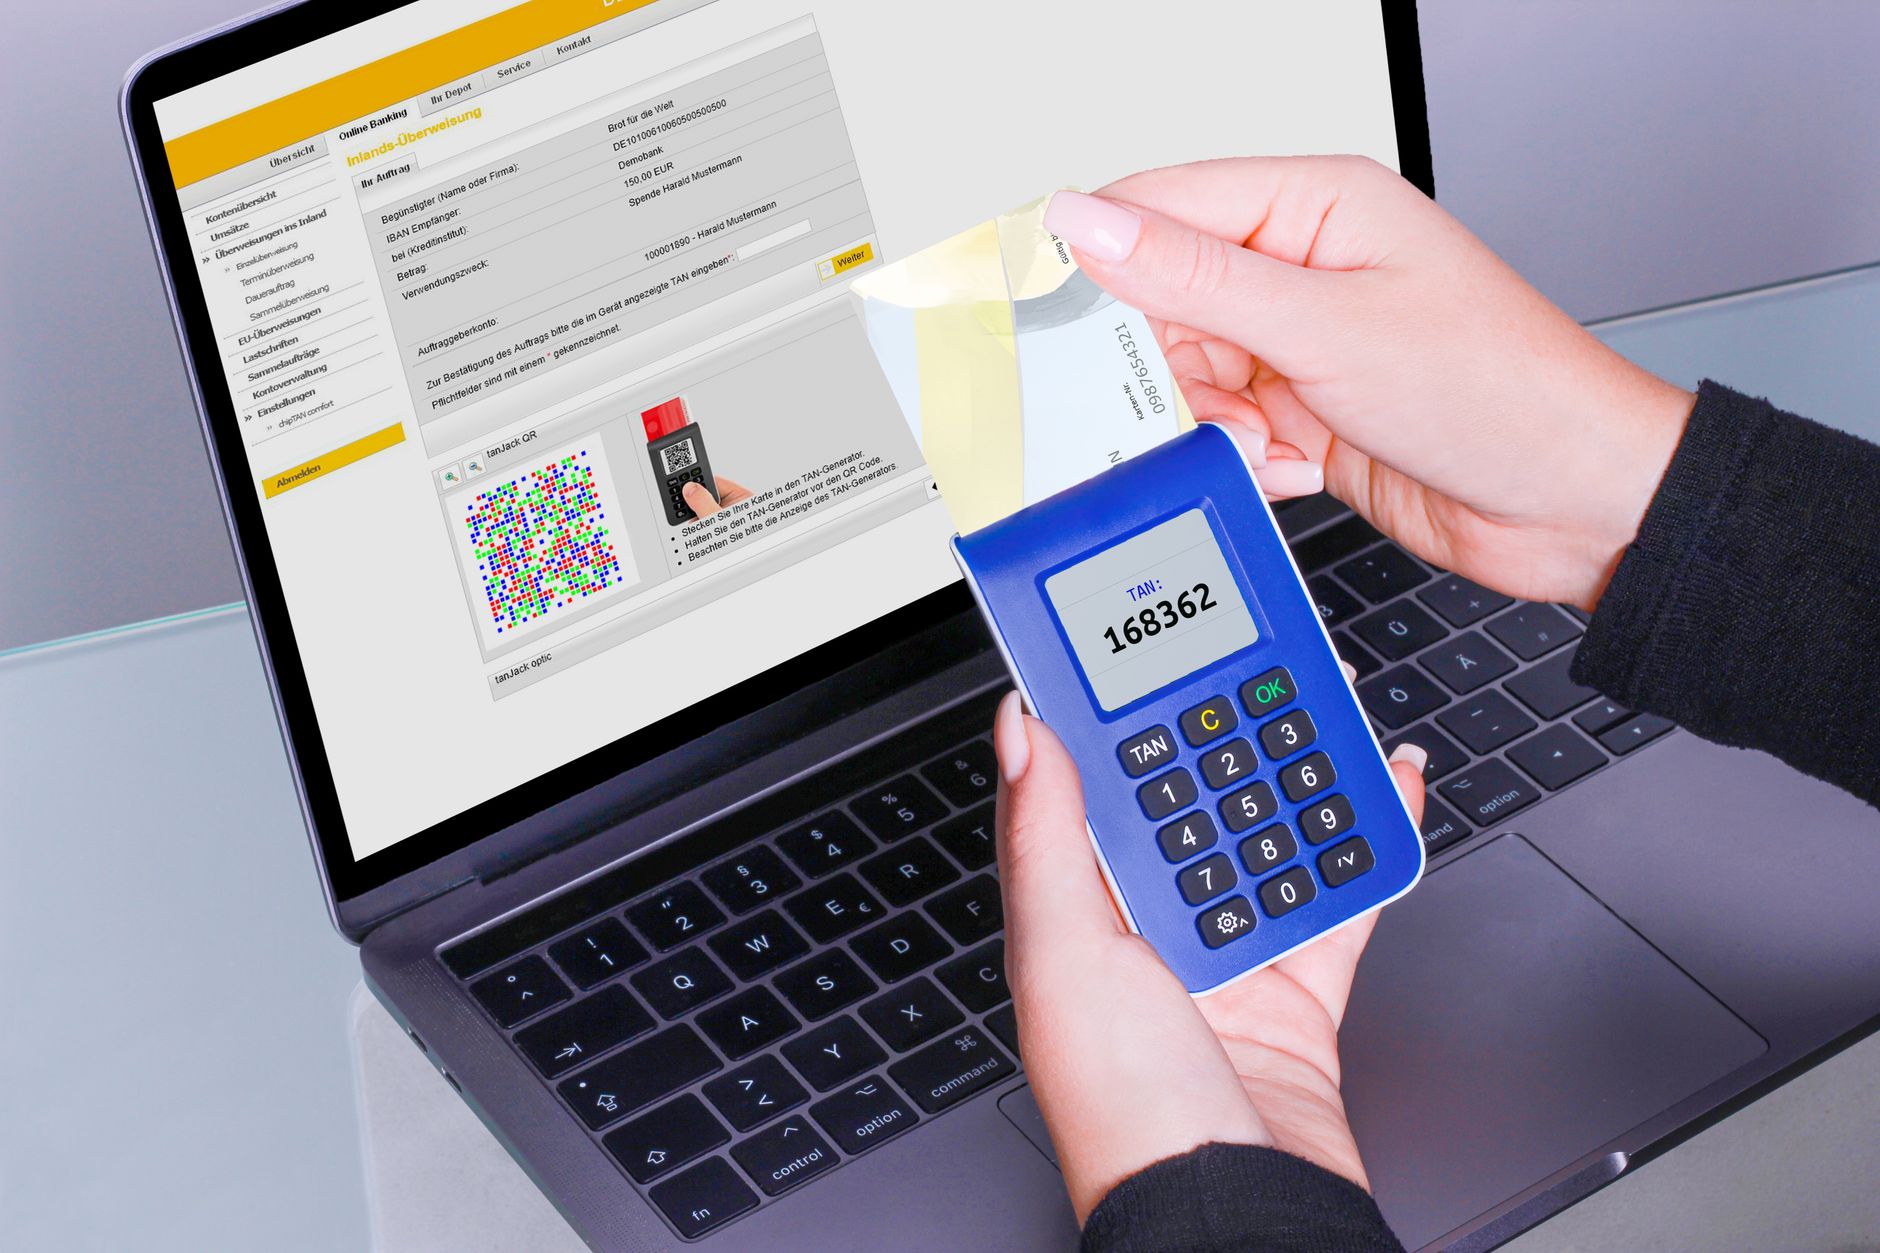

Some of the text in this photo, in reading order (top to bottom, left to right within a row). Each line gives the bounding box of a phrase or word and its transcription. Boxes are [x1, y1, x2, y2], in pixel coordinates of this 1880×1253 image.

[556, 35, 592, 55] Kontakt
[496, 60, 531, 79] Service
[430, 82, 472, 105] Ihr Depot
[338, 108, 408, 141] Online Banking
[607, 100, 675, 133] Brot für die Welt
[612, 98, 727, 152] DE10100610060500500500
[346, 107, 482, 168] Inlands-Überweisung
[269, 144, 315, 168] Übersicht
[617, 146, 664, 171] Demobank
[360, 164, 411, 189] Ihr Auftrag
[623, 161, 674, 188] 150,00 EUR
[628, 155, 743, 207] Spende Harald Mustermann
[381, 163, 520, 225] Begünstigter (Name oder Firma):
[205, 190, 277, 225] Kontenübersicht
[210, 222, 250, 242] Umsätze
[215, 208, 327, 260] Überweisungen ins Inland
[386, 208, 461, 244] IBAN Empfänger:
[644, 201, 777, 261] 100001890 Harald Mustermann
[391, 225, 469, 263] bei (Kreditinstitut):
[1055, 241, 1070, 265] Gültig
[239, 253, 315, 287] Terminüberweisung
[837, 251, 865, 267] Weiter
[396, 264, 429, 282] Betrag:
[401, 259, 489, 301] Verwendungszweck:
[244, 279, 296, 305] Dauerauftrag
[249, 284, 330, 322] Sammelüberweisung
[238, 307, 322, 346] EU-Überweisungen
[418, 318, 499, 357] Auftraggeberkonto:
[425, 377, 442, 390] Zur
[442, 356, 495, 383] Bestätigung
[495, 348, 513, 361] des
[514, 332, 550, 354] Auftrags
[550, 324, 570, 337] bitte
[571, 318, 585, 329] die
[585, 312, 597, 323] im
[598, 300, 623, 317] Gerät
[623, 282, 670, 307] angezeigte
[670, 272, 690, 286] TAN
[242, 336, 299, 364] Lastschriften
[247, 347, 321, 382] Sammelaufträge
[431, 323, 622, 410] Pflichtfelder sind mit einem gekennzeichnet.
[1114, 321, 1166, 415] 0987654321
[252, 364, 328, 400] Kontoverwaltung
[257, 389, 316, 418] Einstellungen
[1122, 381, 1145, 421] Karten-Nr.
[278, 400, 335, 428] chipTAN comfort
[486, 430, 538, 459] tanJack QR
[1107, 450, 1124, 466] N
[276, 464, 321, 489] Abmelden
[681, 450, 865, 537] Stecken Sie Ihre Karte in den TAN-Generator.
[684, 456, 883, 550] Halten Sie den TAN-Generator vor den QR Code.
[687, 462, 899, 562] Beachten Sie bitte die Anzeige des TAN-Generators.
[1126, 579, 1163, 603] TAN:
[1103, 579, 1218, 655] 168362
[1388, 620, 1408, 636] Ü
[494, 653, 553, 684] tanJack optic
[1455, 653, 1477, 670] Ä
[1255, 678, 1287, 704] OK
[1388, 687, 1409, 703] Ö
[1200, 709, 1220, 731] C
[1280, 723, 1298, 745] 3
[1129, 735, 1169, 766] TAN
[1220, 752, 1240, 776] 2
[1300, 765, 1318, 787] 6
[970, 772, 987, 787] 6
[1162, 782, 1177, 804] 1
[1479, 790, 1520, 814] option
[897, 807, 915, 822] 5
[1241, 794, 1258, 818] 5
[1320, 808, 1337, 830] 9
[971, 826, 989, 841] T
[1182, 825, 1197, 846] 4
[828, 843, 842, 857] 4
[1260, 838, 1278, 861] 8
[898, 863, 920, 879] R
[1197, 866, 1212, 891] 7
[750, 879, 768, 894] 3
[1280, 882, 1297, 904] 0
[824, 899, 845, 916] E
[966, 900, 981, 916] F
[675, 916, 694, 931] 2
[745, 934, 770, 953] W
[890, 938, 910, 954] D
[599, 953, 614, 966] 1
[673, 974, 695, 990] Q
[815, 975, 835, 991] S
[978, 967, 998, 982] C
[741, 1015, 759, 1031] A
[900, 1004, 923, 1022] X
[823, 1043, 841, 1059] Y
[931, 1056, 999, 1098] command
[856, 1108, 902, 1138] option
[772, 1148, 823, 1181] control
[692, 1208, 711, 1221] fn
